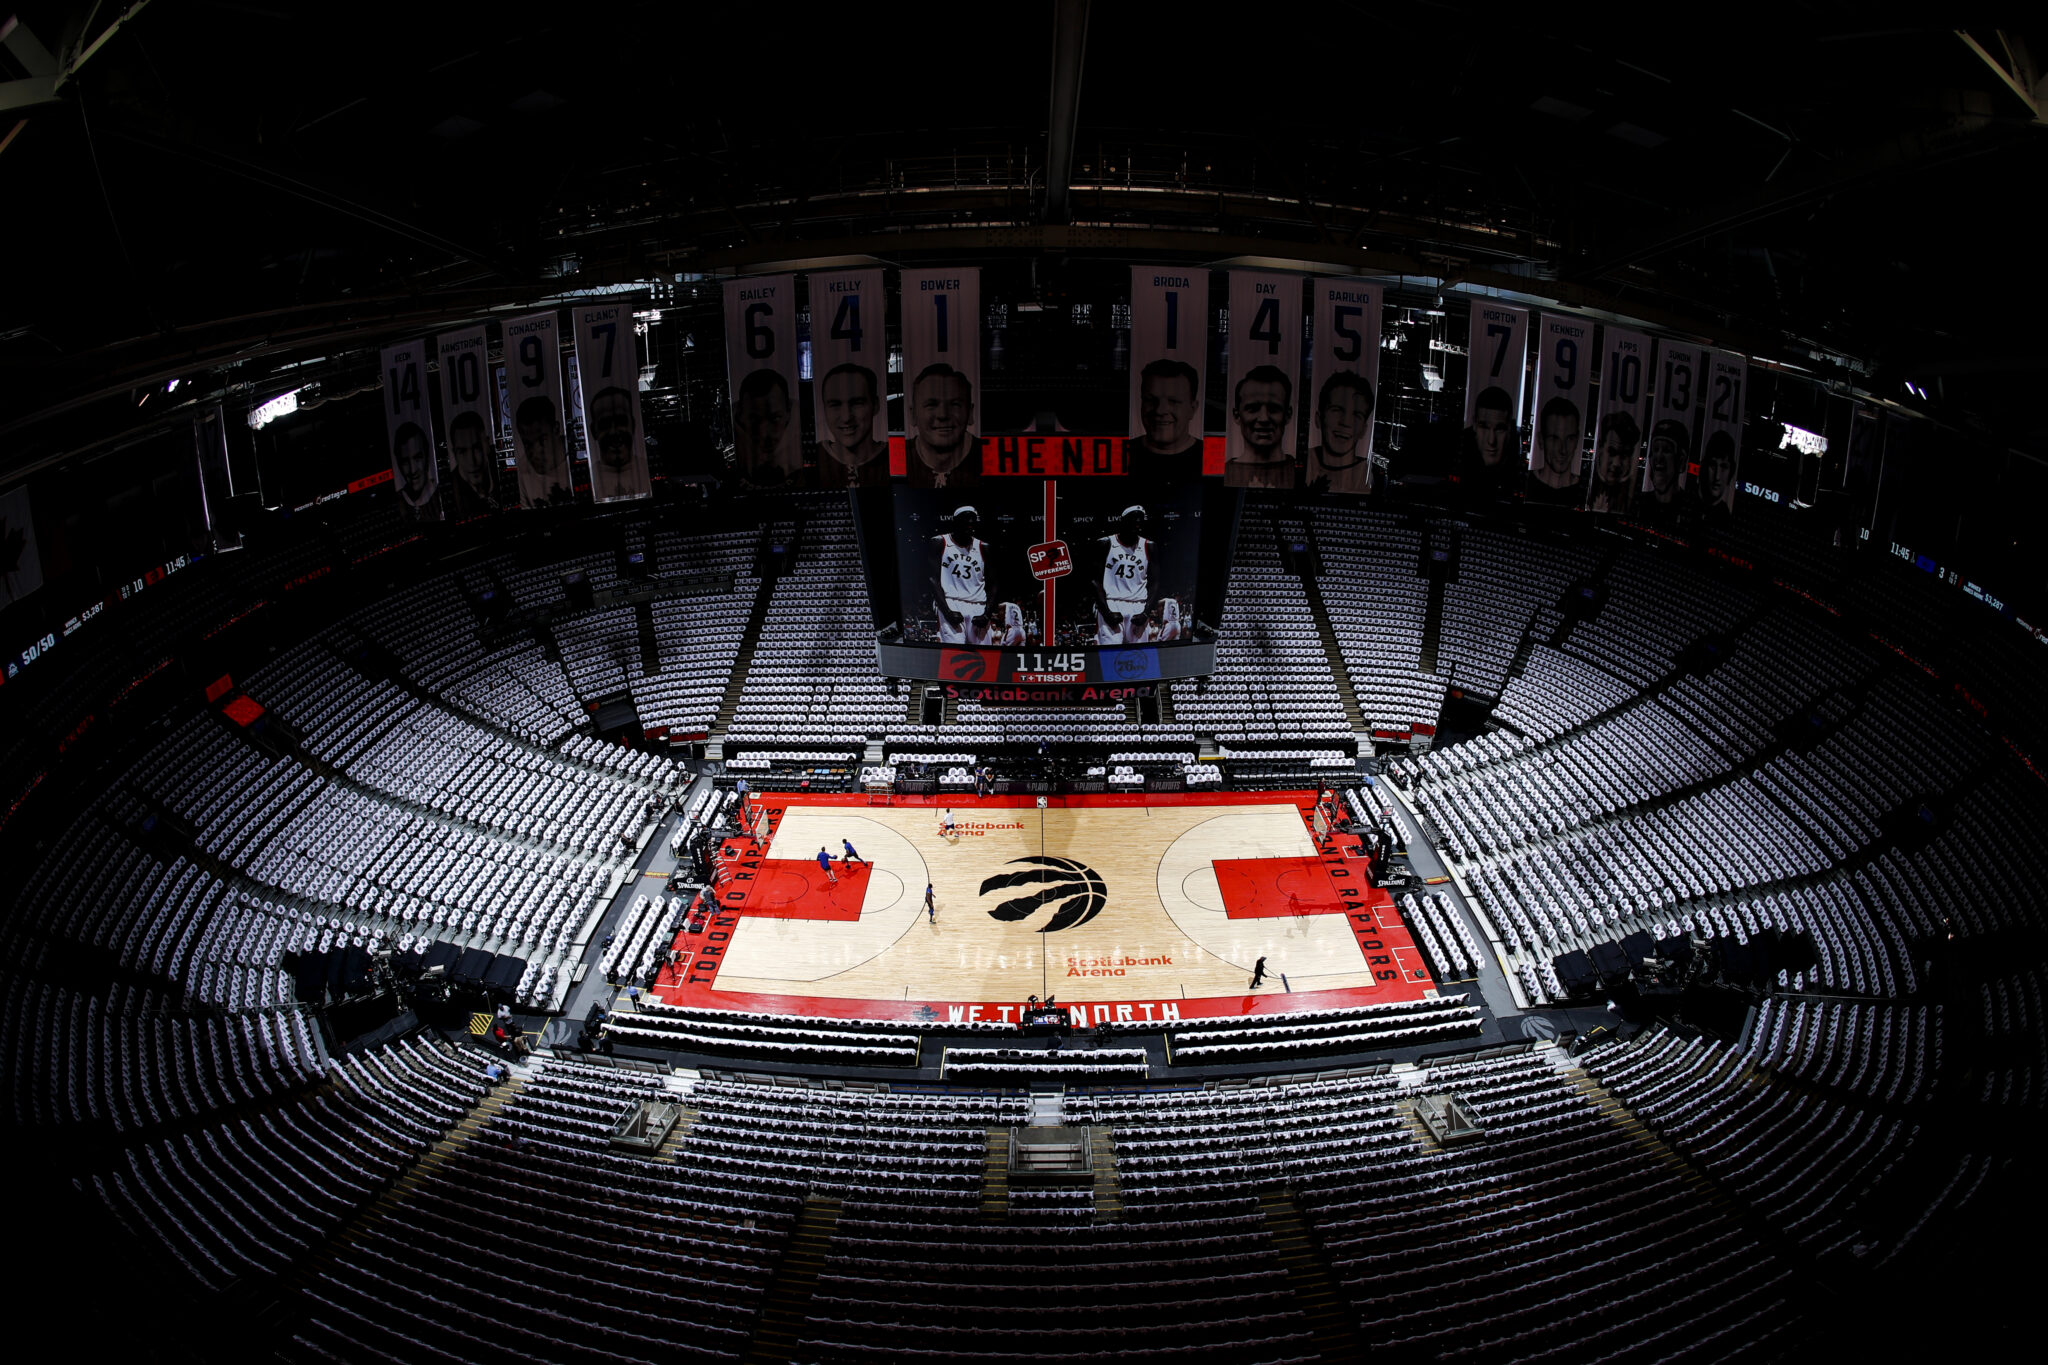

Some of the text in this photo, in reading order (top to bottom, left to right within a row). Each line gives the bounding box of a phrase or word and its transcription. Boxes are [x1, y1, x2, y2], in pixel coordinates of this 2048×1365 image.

[829, 280, 861, 293] KELLY
[920, 279, 960, 291] BOWER
[1154, 276, 1190, 288] BRODA
[1256, 283, 1276, 295] DAY
[740, 287, 776, 301] BAILEY
[1329, 290, 1369, 304] BARILKO
[585, 307, 619, 323] CLANCY
[830, 295, 862, 352] 4
[934, 294, 948, 352] 1
[1165, 291, 1177, 349] 1
[1483, 309, 1516, 324] HORTON
[508, 319, 551, 336] CONACHER
[745, 302, 775, 359] 6
[1250, 298, 1281, 355] 4
[1333, 305, 1362, 361] 5
[1550, 323, 1585, 338] KENNEDY
[591, 322, 616, 378] 7
[1487, 324, 1511, 377] 7
[1618, 340, 1638, 354] APPS
[519, 335, 544, 388] 9
[1555, 338, 1578, 391] 9
[447, 352, 480, 405] 10
[1610, 351, 1641, 404] 10
[1663, 361, 1692, 412] 13
[390, 362, 420, 415] 14
[1712, 375, 1741, 424] 21
[1745, 482, 1780, 503] 50/50
[1860, 527, 1870, 541] 10
[1890, 541, 1911, 561] 11:45
[165, 555, 186, 575] 11:45
[942, 553, 982, 573] RAPTORS
[951, 563, 972, 580] 43
[1035, 564, 1072, 577] DIFFERENCE
[1106, 553, 1145, 572] RAPTORS
[1115, 564, 1135, 579] 43
[132, 578, 144, 593] 10
[82, 601, 104, 621] $3,287
[1985, 593, 2004, 611] $3,287
[22, 633, 55, 665] 50/50
[1016, 653, 1086, 672] 11:45
[946, 684, 1150, 701] Scotiabank Arena
[1079, 782, 1105, 791] PLAYOFFS
[1155, 781, 1180, 790] PLAYOFFS
[677, 882, 707, 890] SPALDING
[1377, 878, 1406, 887] SPALDING
[689, 891, 746, 984] TORONTO
[1338, 888, 1397, 981] RAPTORS
[1067, 955, 1173, 967] Scotiabank
[1067, 967, 1126, 977] Arena
[948, 1005, 984, 1023] WE
[1070, 1003, 1180, 1027] NORTH
